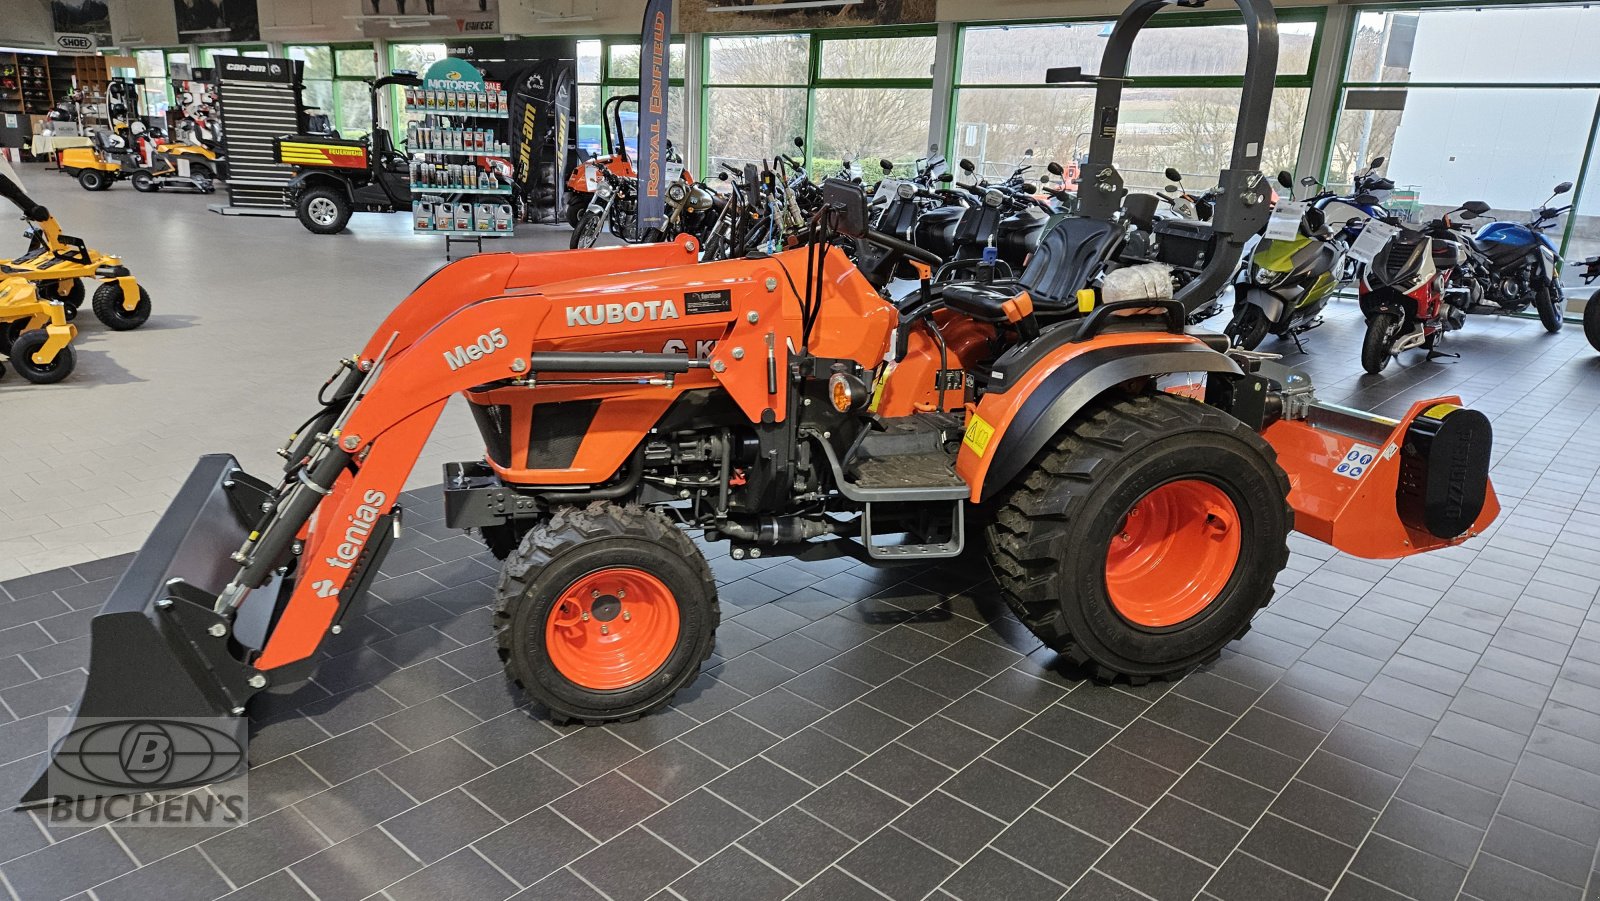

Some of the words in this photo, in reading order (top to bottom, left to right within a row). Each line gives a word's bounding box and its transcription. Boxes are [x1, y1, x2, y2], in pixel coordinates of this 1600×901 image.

[62, 38, 88, 47] SHOEI
[650, 11, 665, 114] ENFIELD
[427, 79, 482, 92] MOTOREX
[484, 82, 501, 91] SALE
[328, 148, 364, 157] FEUERWEHR
[647, 119, 661, 197] ROYAL
[566, 299, 679, 327] KUBOTA
[442, 327, 508, 371] Me05
[325, 488, 386, 569] tenias
